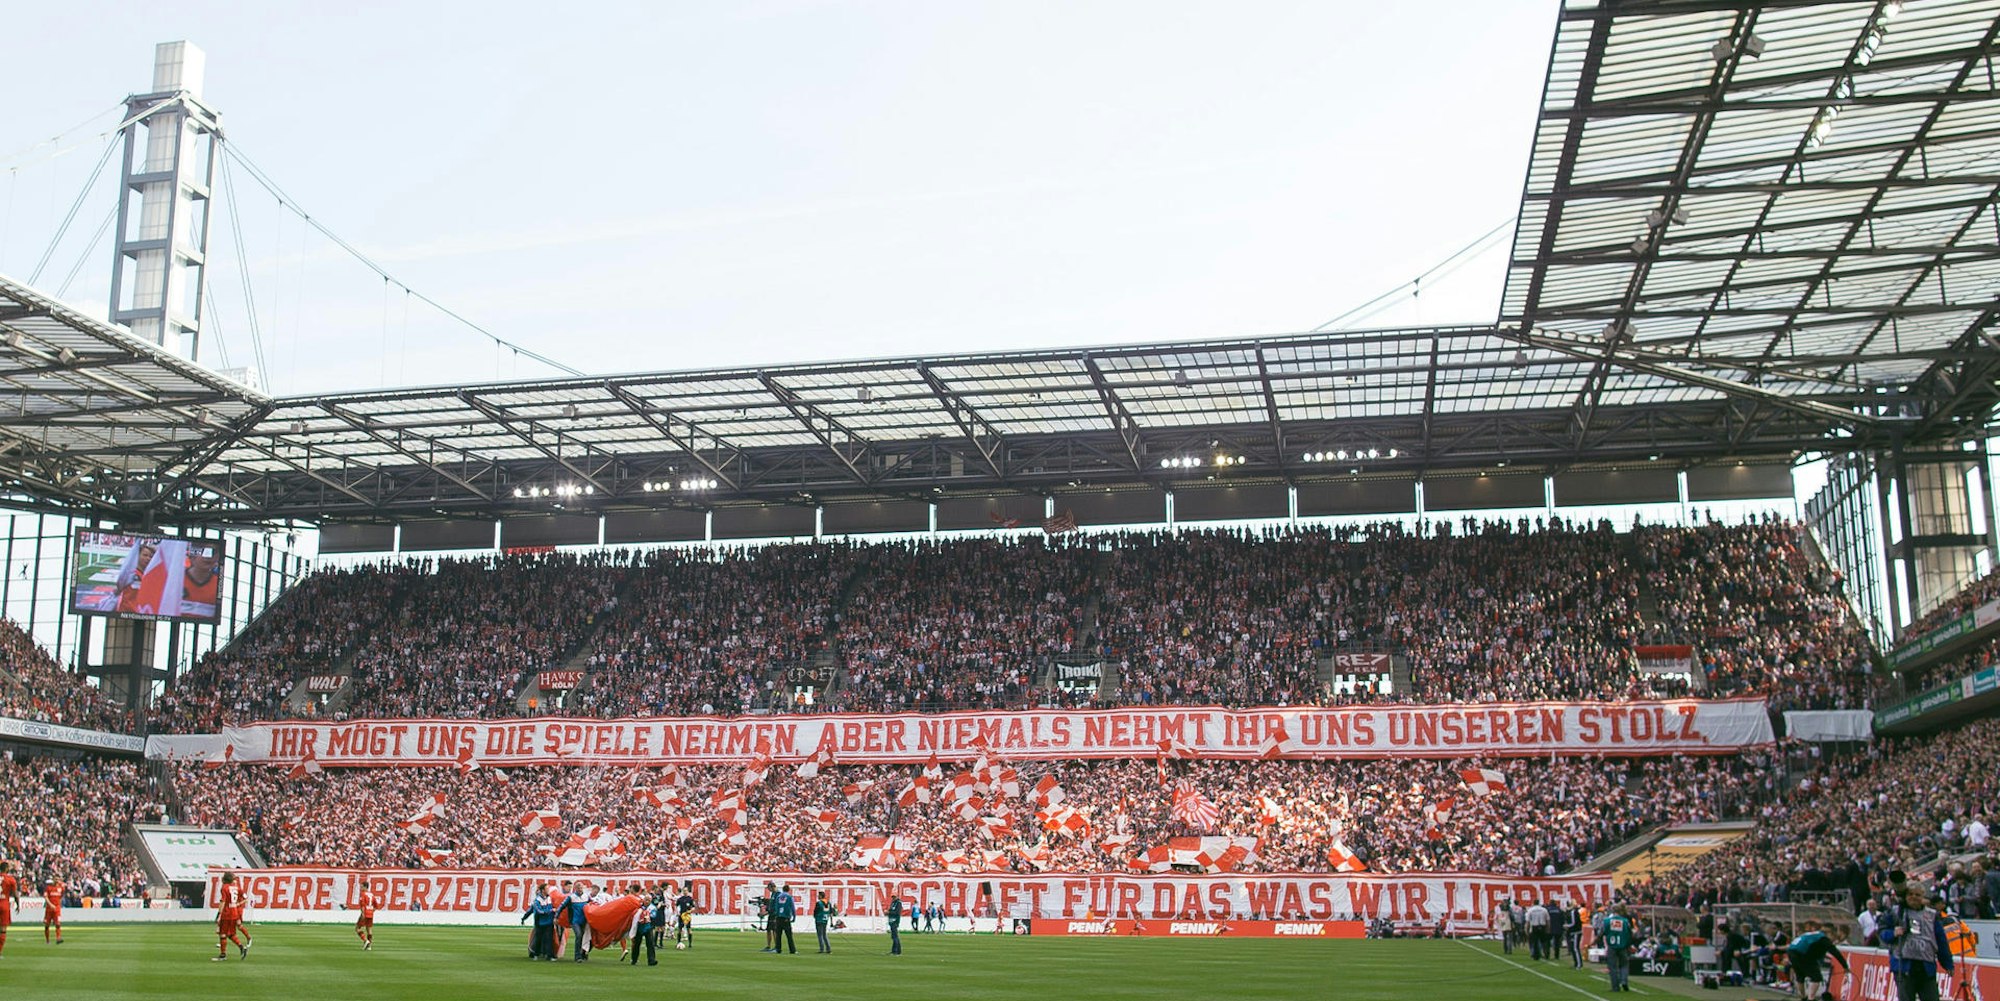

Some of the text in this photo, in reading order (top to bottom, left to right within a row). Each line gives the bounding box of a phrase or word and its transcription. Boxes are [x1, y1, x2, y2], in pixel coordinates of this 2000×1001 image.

[1057, 662, 1101, 680] TROIKA
[552, 680, 574, 690] KÖLN
[52, 727, 64, 739] Die
[86, 734, 99, 744] aus
[269, 728, 318, 757] IHR
[326, 724, 407, 757] MÖGT
[416, 726, 476, 757] UNS
[485, 725, 535, 756] DIE
[544, 723, 651, 756] SPIELE
[817, 720, 906, 753] ABER
[917, 716, 1070, 751] NIEMALS
[1083, 713, 1211, 748] NEHMT
[1299, 713, 1375, 746] UNS
[1388, 709, 1564, 746] UNSEREN
[762, 879, 1049, 918] EIDENSCHAFT
[1062, 876, 1143, 919] FÜR
[1245, 881, 1332, 920] WAS
[1347, 881, 1431, 920] WIR
[1642, 959, 1669, 976] sky
[1860, 963, 1890, 1001] FOLGE
